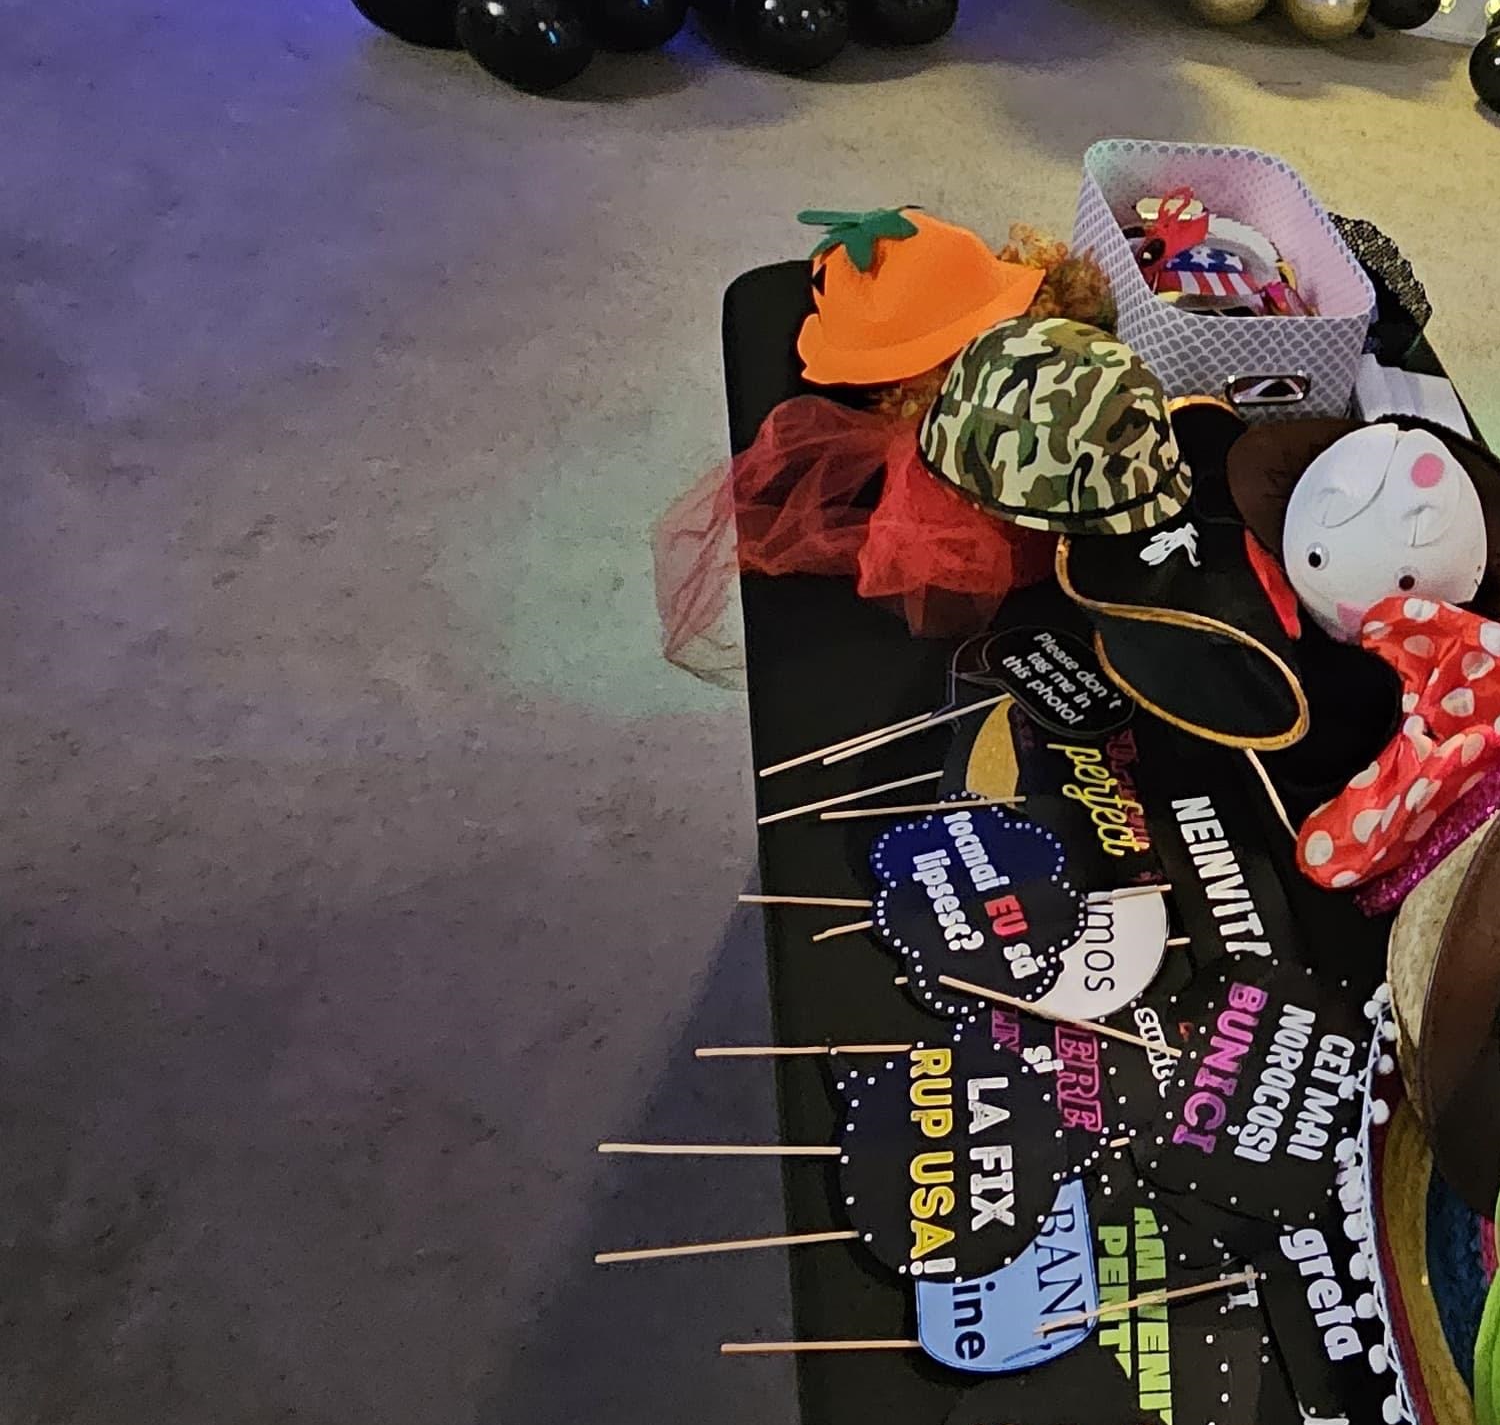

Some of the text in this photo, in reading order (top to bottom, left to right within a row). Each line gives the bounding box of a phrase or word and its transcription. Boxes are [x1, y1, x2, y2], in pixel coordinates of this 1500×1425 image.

[1001, 655, 1085, 726] this photo!
[1026, 651, 1093, 710] tag me in
[1033, 631, 1080, 672] Please
[1046, 742, 1151, 858] perfect
[943, 811, 1011, 893] tocmai
[911, 848, 986, 952] lipsesc?
[984, 894, 1029, 937] EU
[1003, 942, 1048, 980] să
[966, 1075, 1012, 1136] LA
[1171, 980, 1270, 1156] BUNICI
[1285, 1033, 1356, 1162] CEI MAI
[909, 1047, 957, 1277] RUP USA!
[968, 1144, 1016, 1233] FIX
[1133, 1205, 1167, 1281] AM
